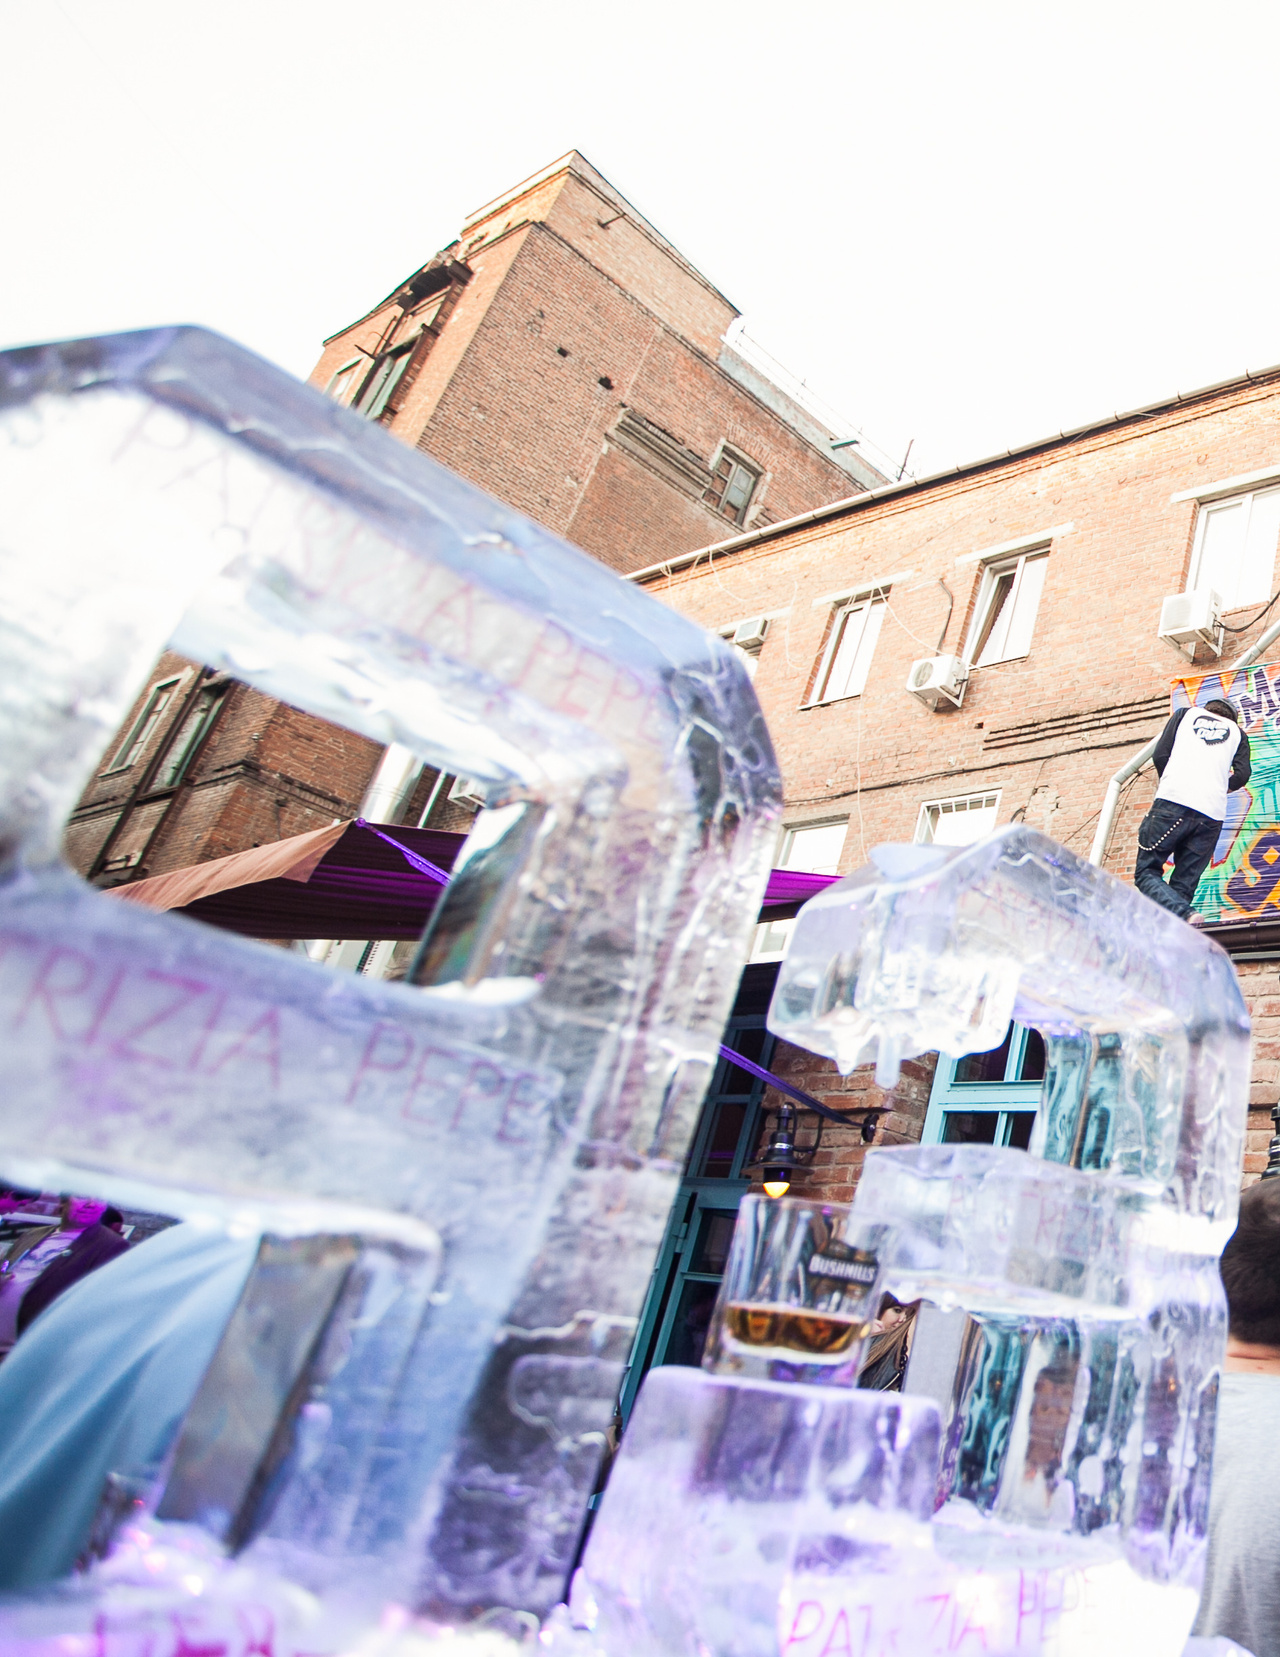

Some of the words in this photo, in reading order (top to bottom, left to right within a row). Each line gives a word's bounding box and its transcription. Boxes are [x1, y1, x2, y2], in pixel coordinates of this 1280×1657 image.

[2, 926, 282, 1088] RIZIA
[343, 1021, 546, 1146] PEPE
[809, 1253, 876, 1282] BUSHMILLS
